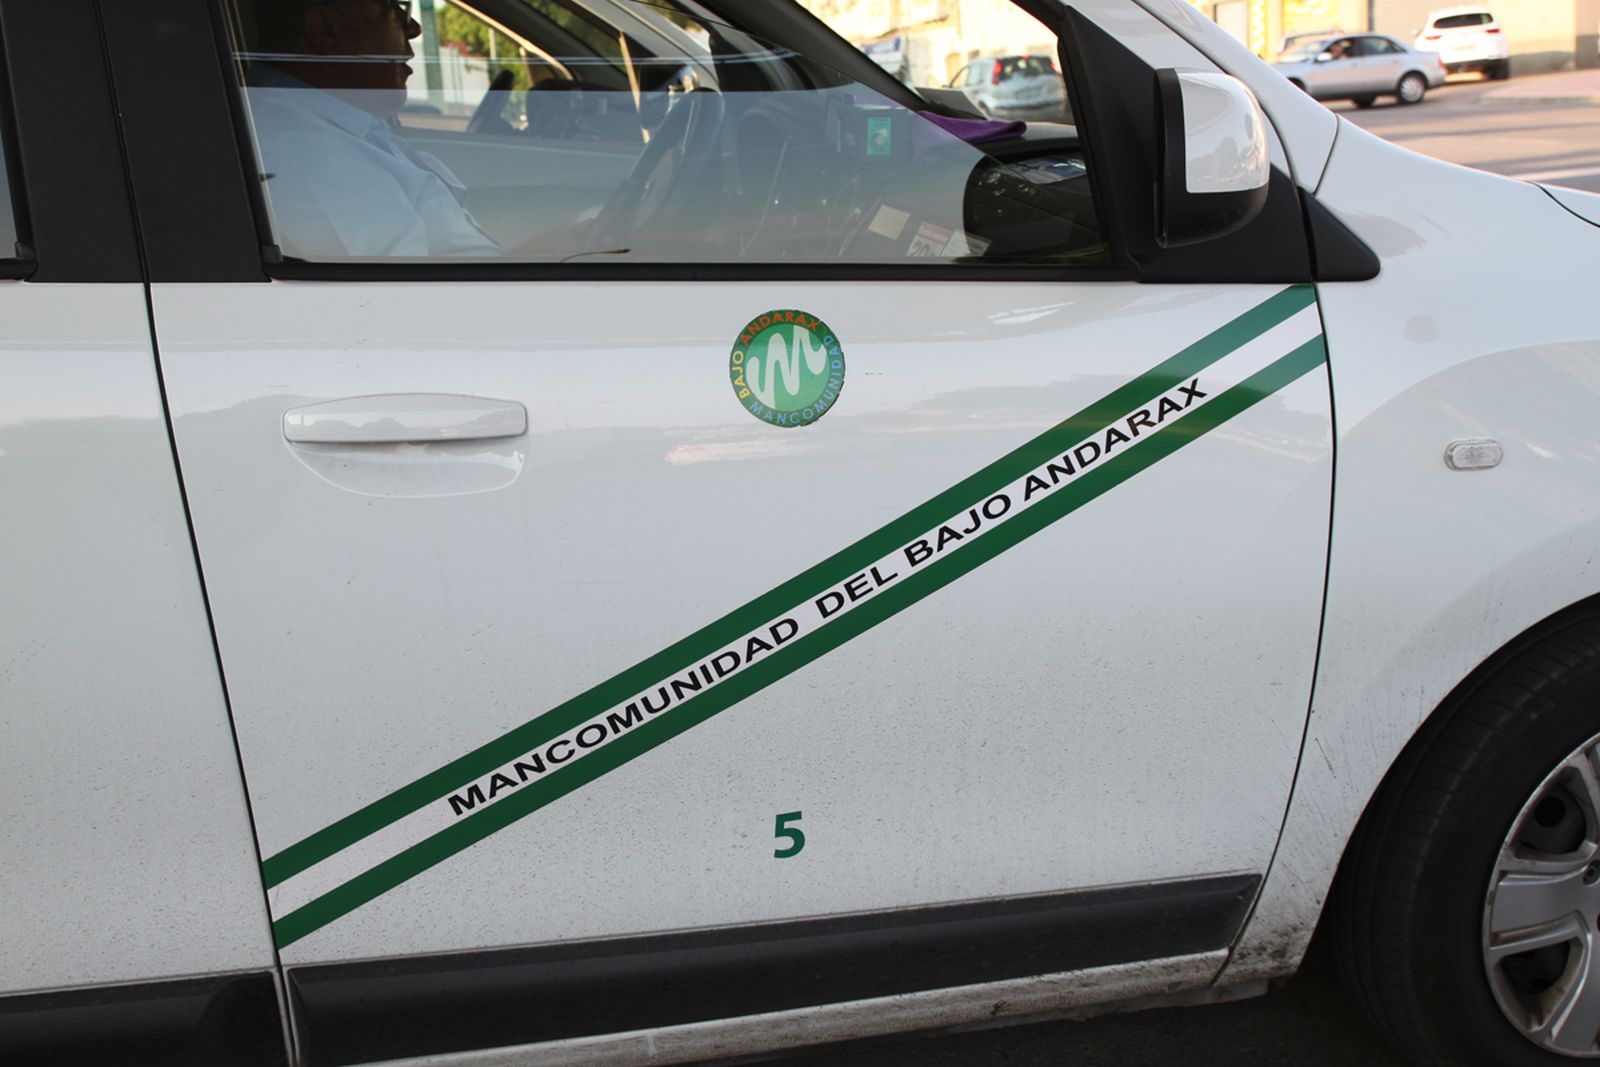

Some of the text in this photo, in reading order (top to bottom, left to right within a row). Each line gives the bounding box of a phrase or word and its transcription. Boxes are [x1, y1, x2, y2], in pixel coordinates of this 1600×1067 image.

[732, 312, 820, 399] BAJO ANDARAX
[750, 335, 842, 424] MANCOMUNIDAD
[447, 378, 1208, 816] MANCOMUNIDAD DEL BAJO ANDARAX
[774, 810, 806, 859] 5
